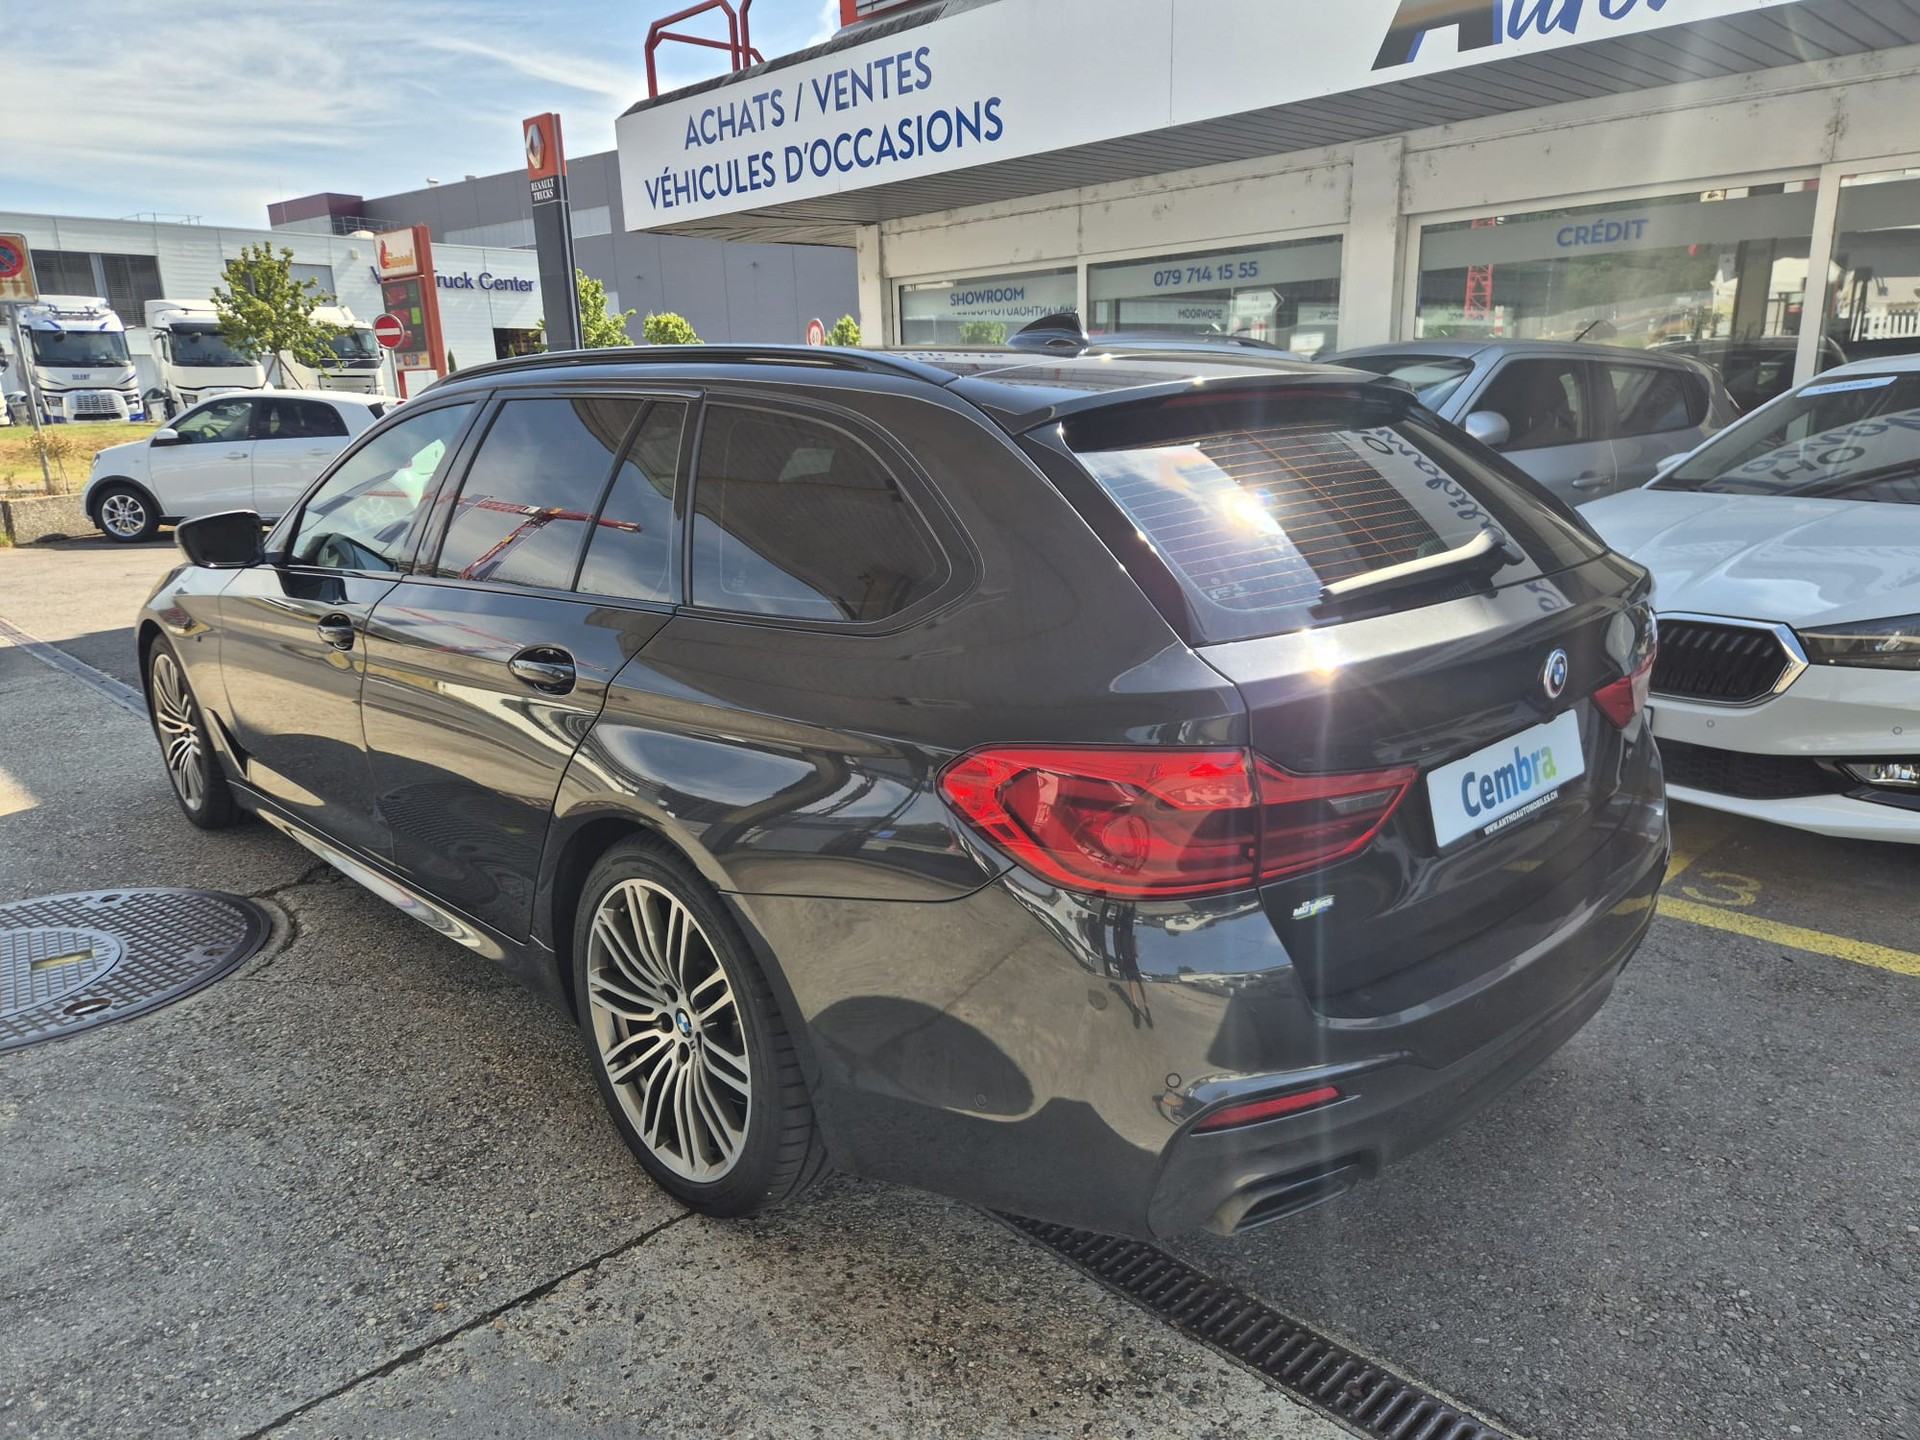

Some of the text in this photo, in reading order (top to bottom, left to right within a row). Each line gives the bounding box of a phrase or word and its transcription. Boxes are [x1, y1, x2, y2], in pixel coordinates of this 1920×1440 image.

[685, 47, 932, 150] ACHATS / VENTES
[645, 97, 1003, 210] VÉHICULES D'OCCASIONS
[531, 178, 554, 192] RENAULT
[533, 189, 554, 201] TRUCKS
[1557, 219, 1649, 247] CRÉDIT
[434, 270, 534, 292] ruck Center
[1153, 261, 1258, 287] 079 714 15 55
[950, 287, 1025, 307] SHOWROOM
[72, 373, 91, 381] SILENT
[1461, 746, 1557, 818] Cembra
